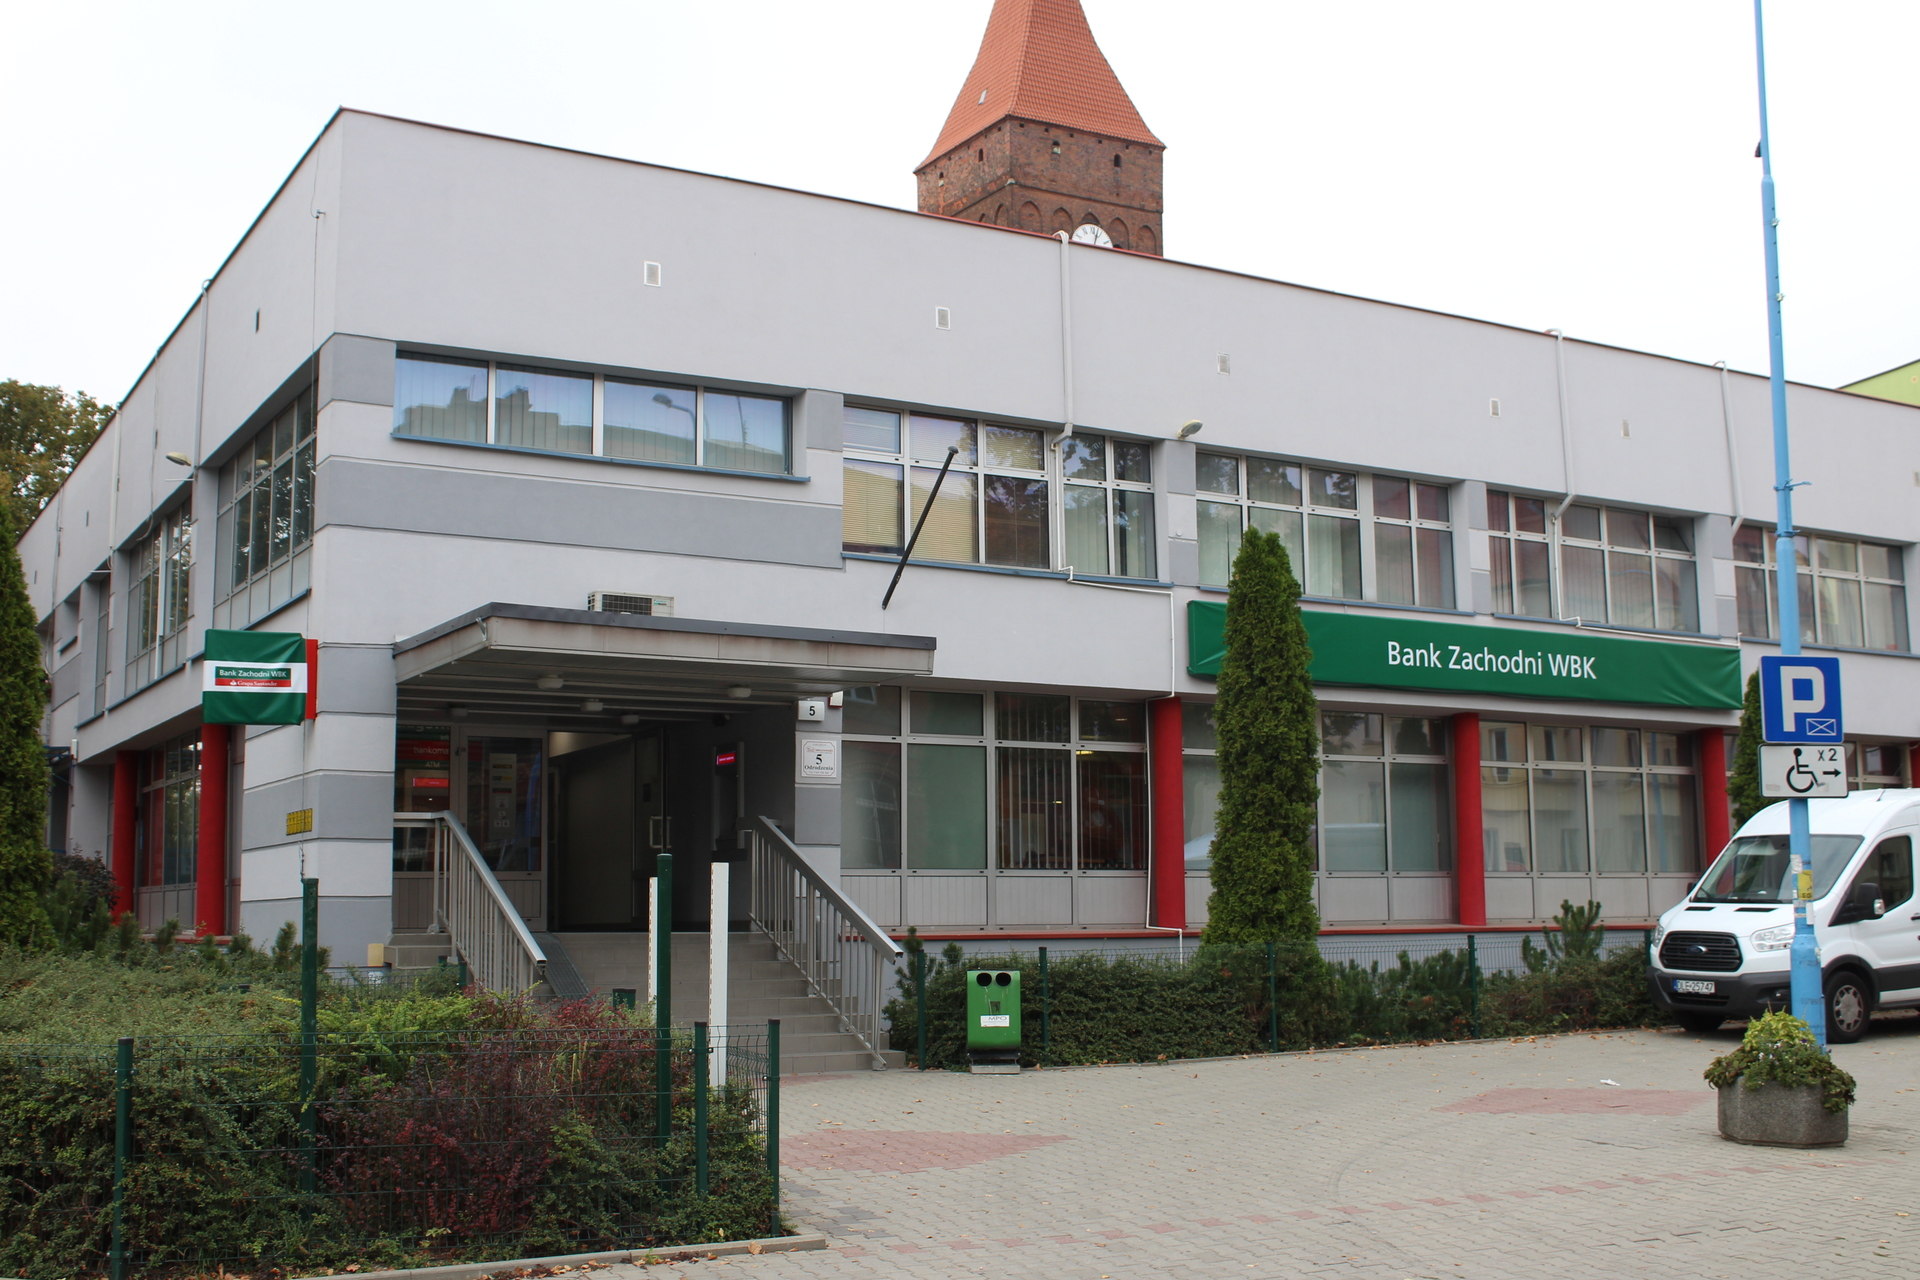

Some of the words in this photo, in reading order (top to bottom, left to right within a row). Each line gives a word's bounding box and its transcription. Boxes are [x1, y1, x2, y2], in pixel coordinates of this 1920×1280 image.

[1387, 641, 1442, 668] Bank
[1448, 645, 1542, 675] Zachodni
[1547, 653, 1597, 679] WBK
[219, 669, 237, 677] Bank
[238, 669, 270, 678] Zachodni
[270, 670, 287, 678] WBK
[1780, 665, 1826, 732] P
[809, 705, 816, 717] 5
[815, 753, 823, 765] 5
